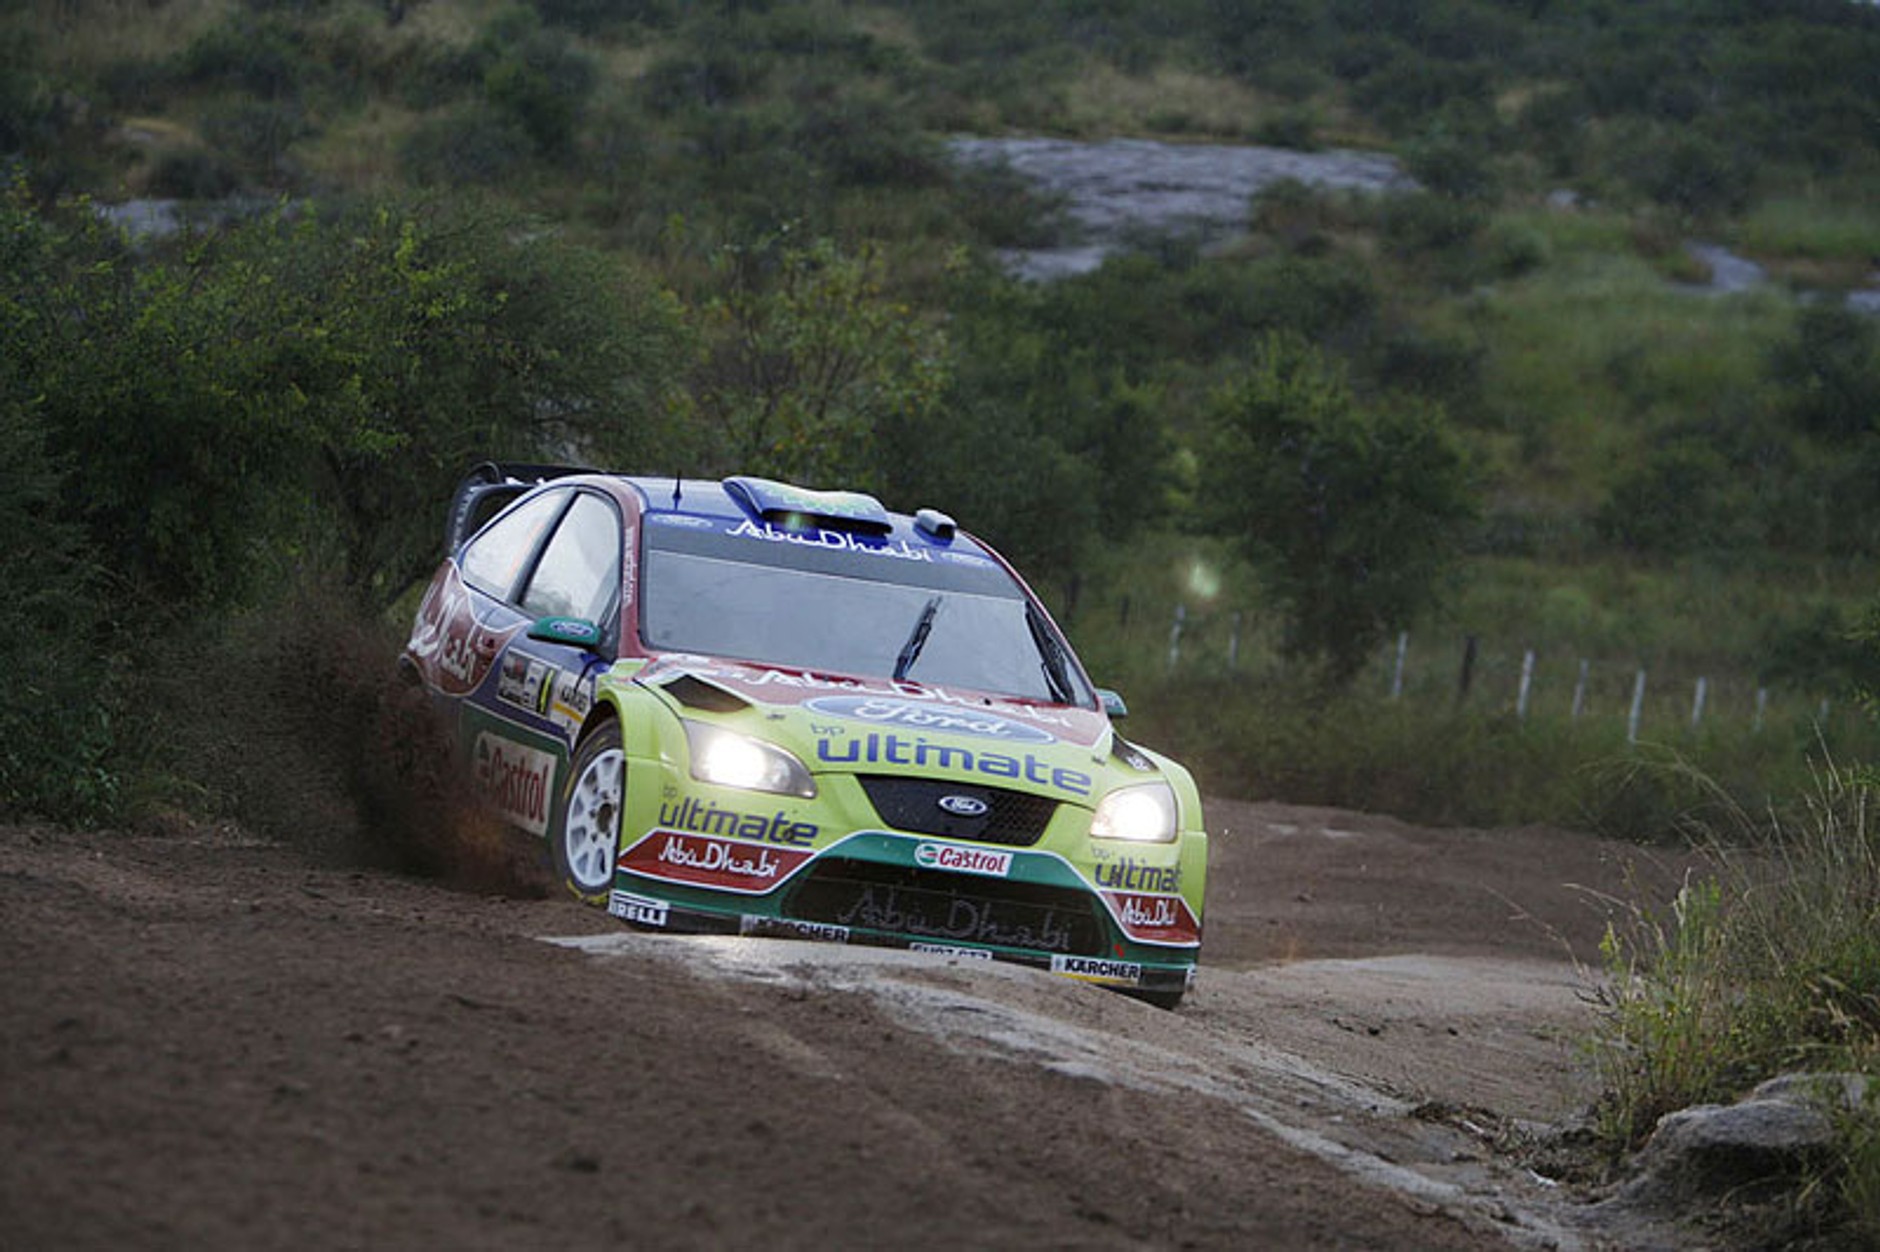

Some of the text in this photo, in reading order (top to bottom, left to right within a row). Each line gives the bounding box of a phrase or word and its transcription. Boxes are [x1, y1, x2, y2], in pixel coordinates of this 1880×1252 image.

[811, 722, 845, 737] bp
[853, 699, 1012, 736] Ford
[817, 732, 1092, 797] ultimate
[658, 796, 819, 847] ultimate
[658, 836, 780, 878] Abu Dhabi
[938, 847, 1007, 874] Castrol
